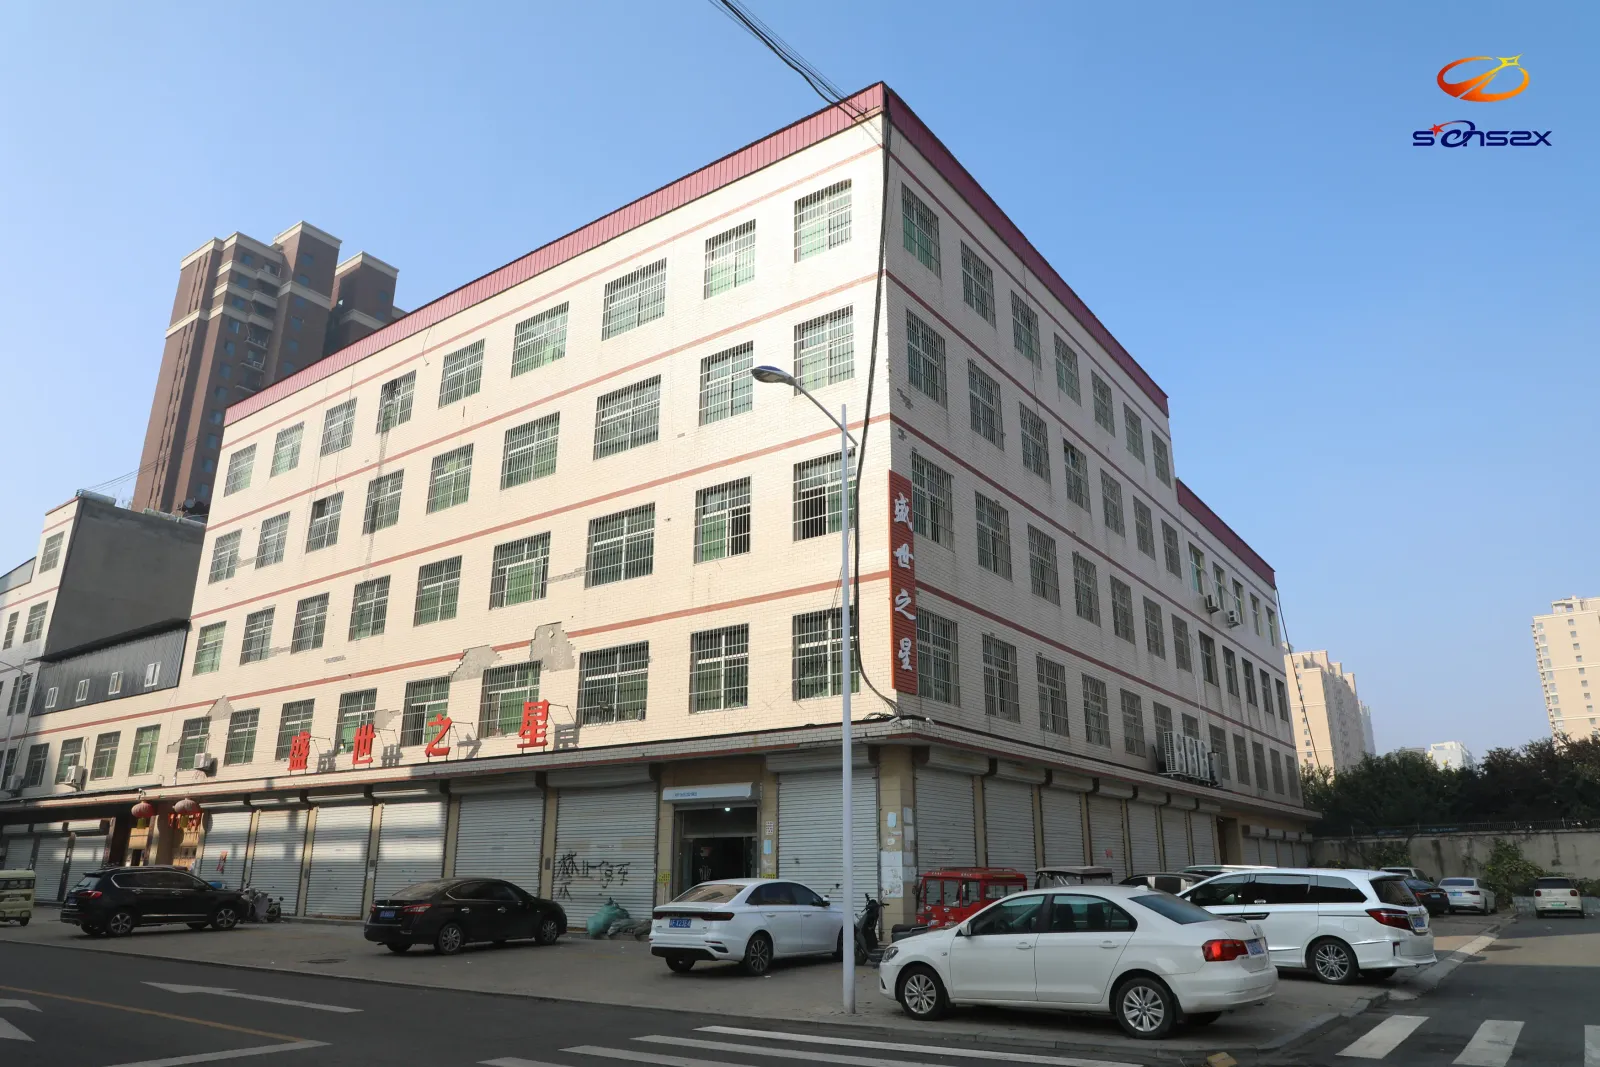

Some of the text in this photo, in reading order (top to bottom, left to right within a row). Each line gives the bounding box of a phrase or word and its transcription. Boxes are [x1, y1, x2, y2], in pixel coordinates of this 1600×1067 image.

[893, 491, 916, 671] 盛世之星
[287, 698, 550, 771] 盛世之星
